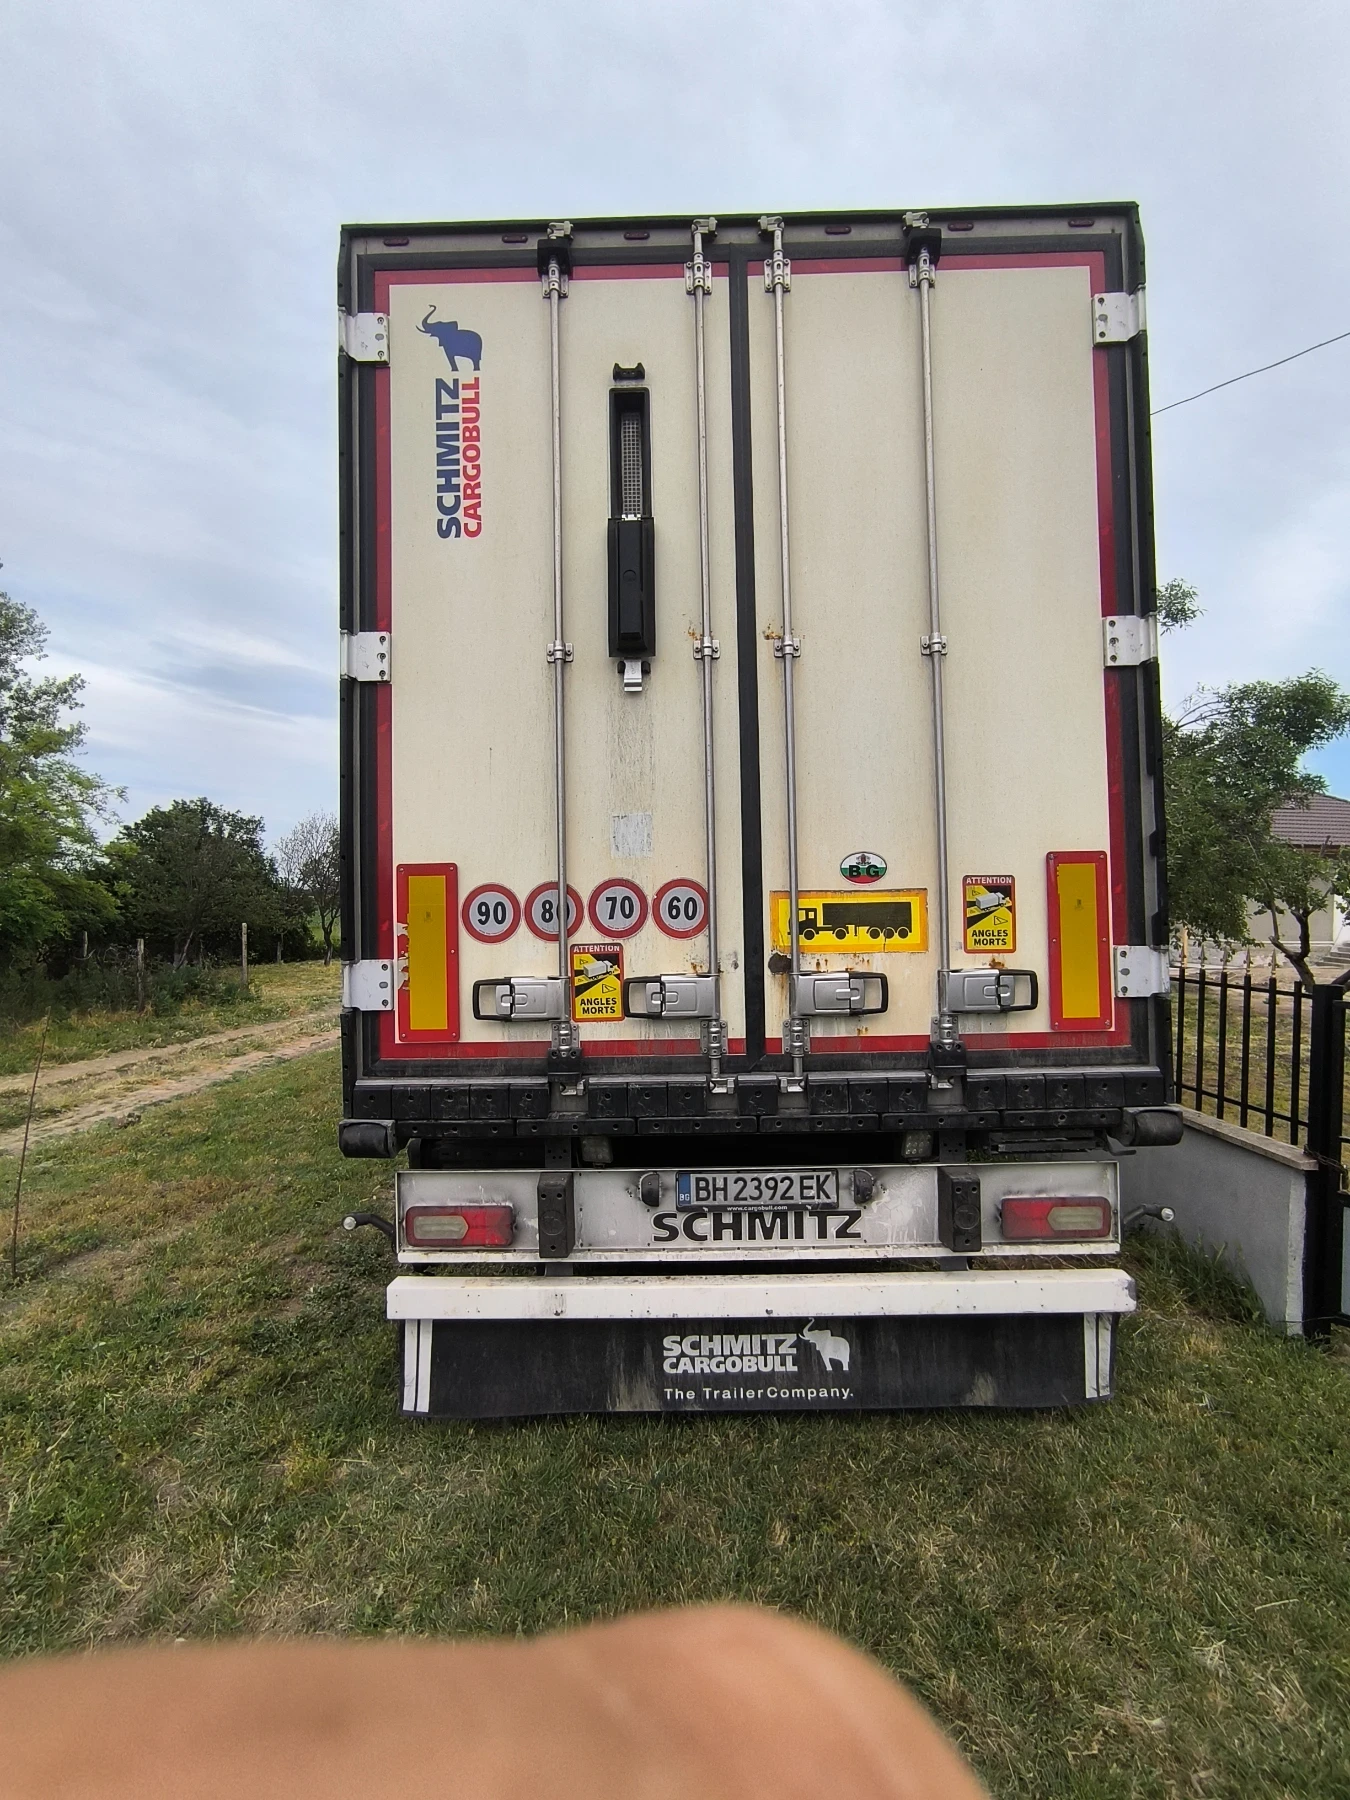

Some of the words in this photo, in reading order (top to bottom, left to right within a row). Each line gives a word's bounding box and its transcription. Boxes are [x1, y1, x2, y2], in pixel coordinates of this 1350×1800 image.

[435, 378, 461, 538] SCHMITZ
[461, 376, 482, 538] CARGOBULL
[849, 864, 879, 878] BG
[966, 876, 1012, 884] ATTENTION
[477, 901, 506, 925] 90
[605, 895, 634, 920] 70
[668, 896, 698, 921] 60
[971, 929, 1008, 937] ANGLES
[573, 944, 620, 953] ATTENTION
[973, 938, 1007, 946] MORTS
[579, 997, 617, 1006] ANGLES
[582, 1005, 616, 1015] MORTS
[679, 1193, 690, 1201] BG
[652, 1210, 862, 1242] SCHMITZ
[663, 1333, 797, 1356] SCHMITZ
[663, 1355, 798, 1374] CARGOBULL
[664, 1388, 695, 1400] The
